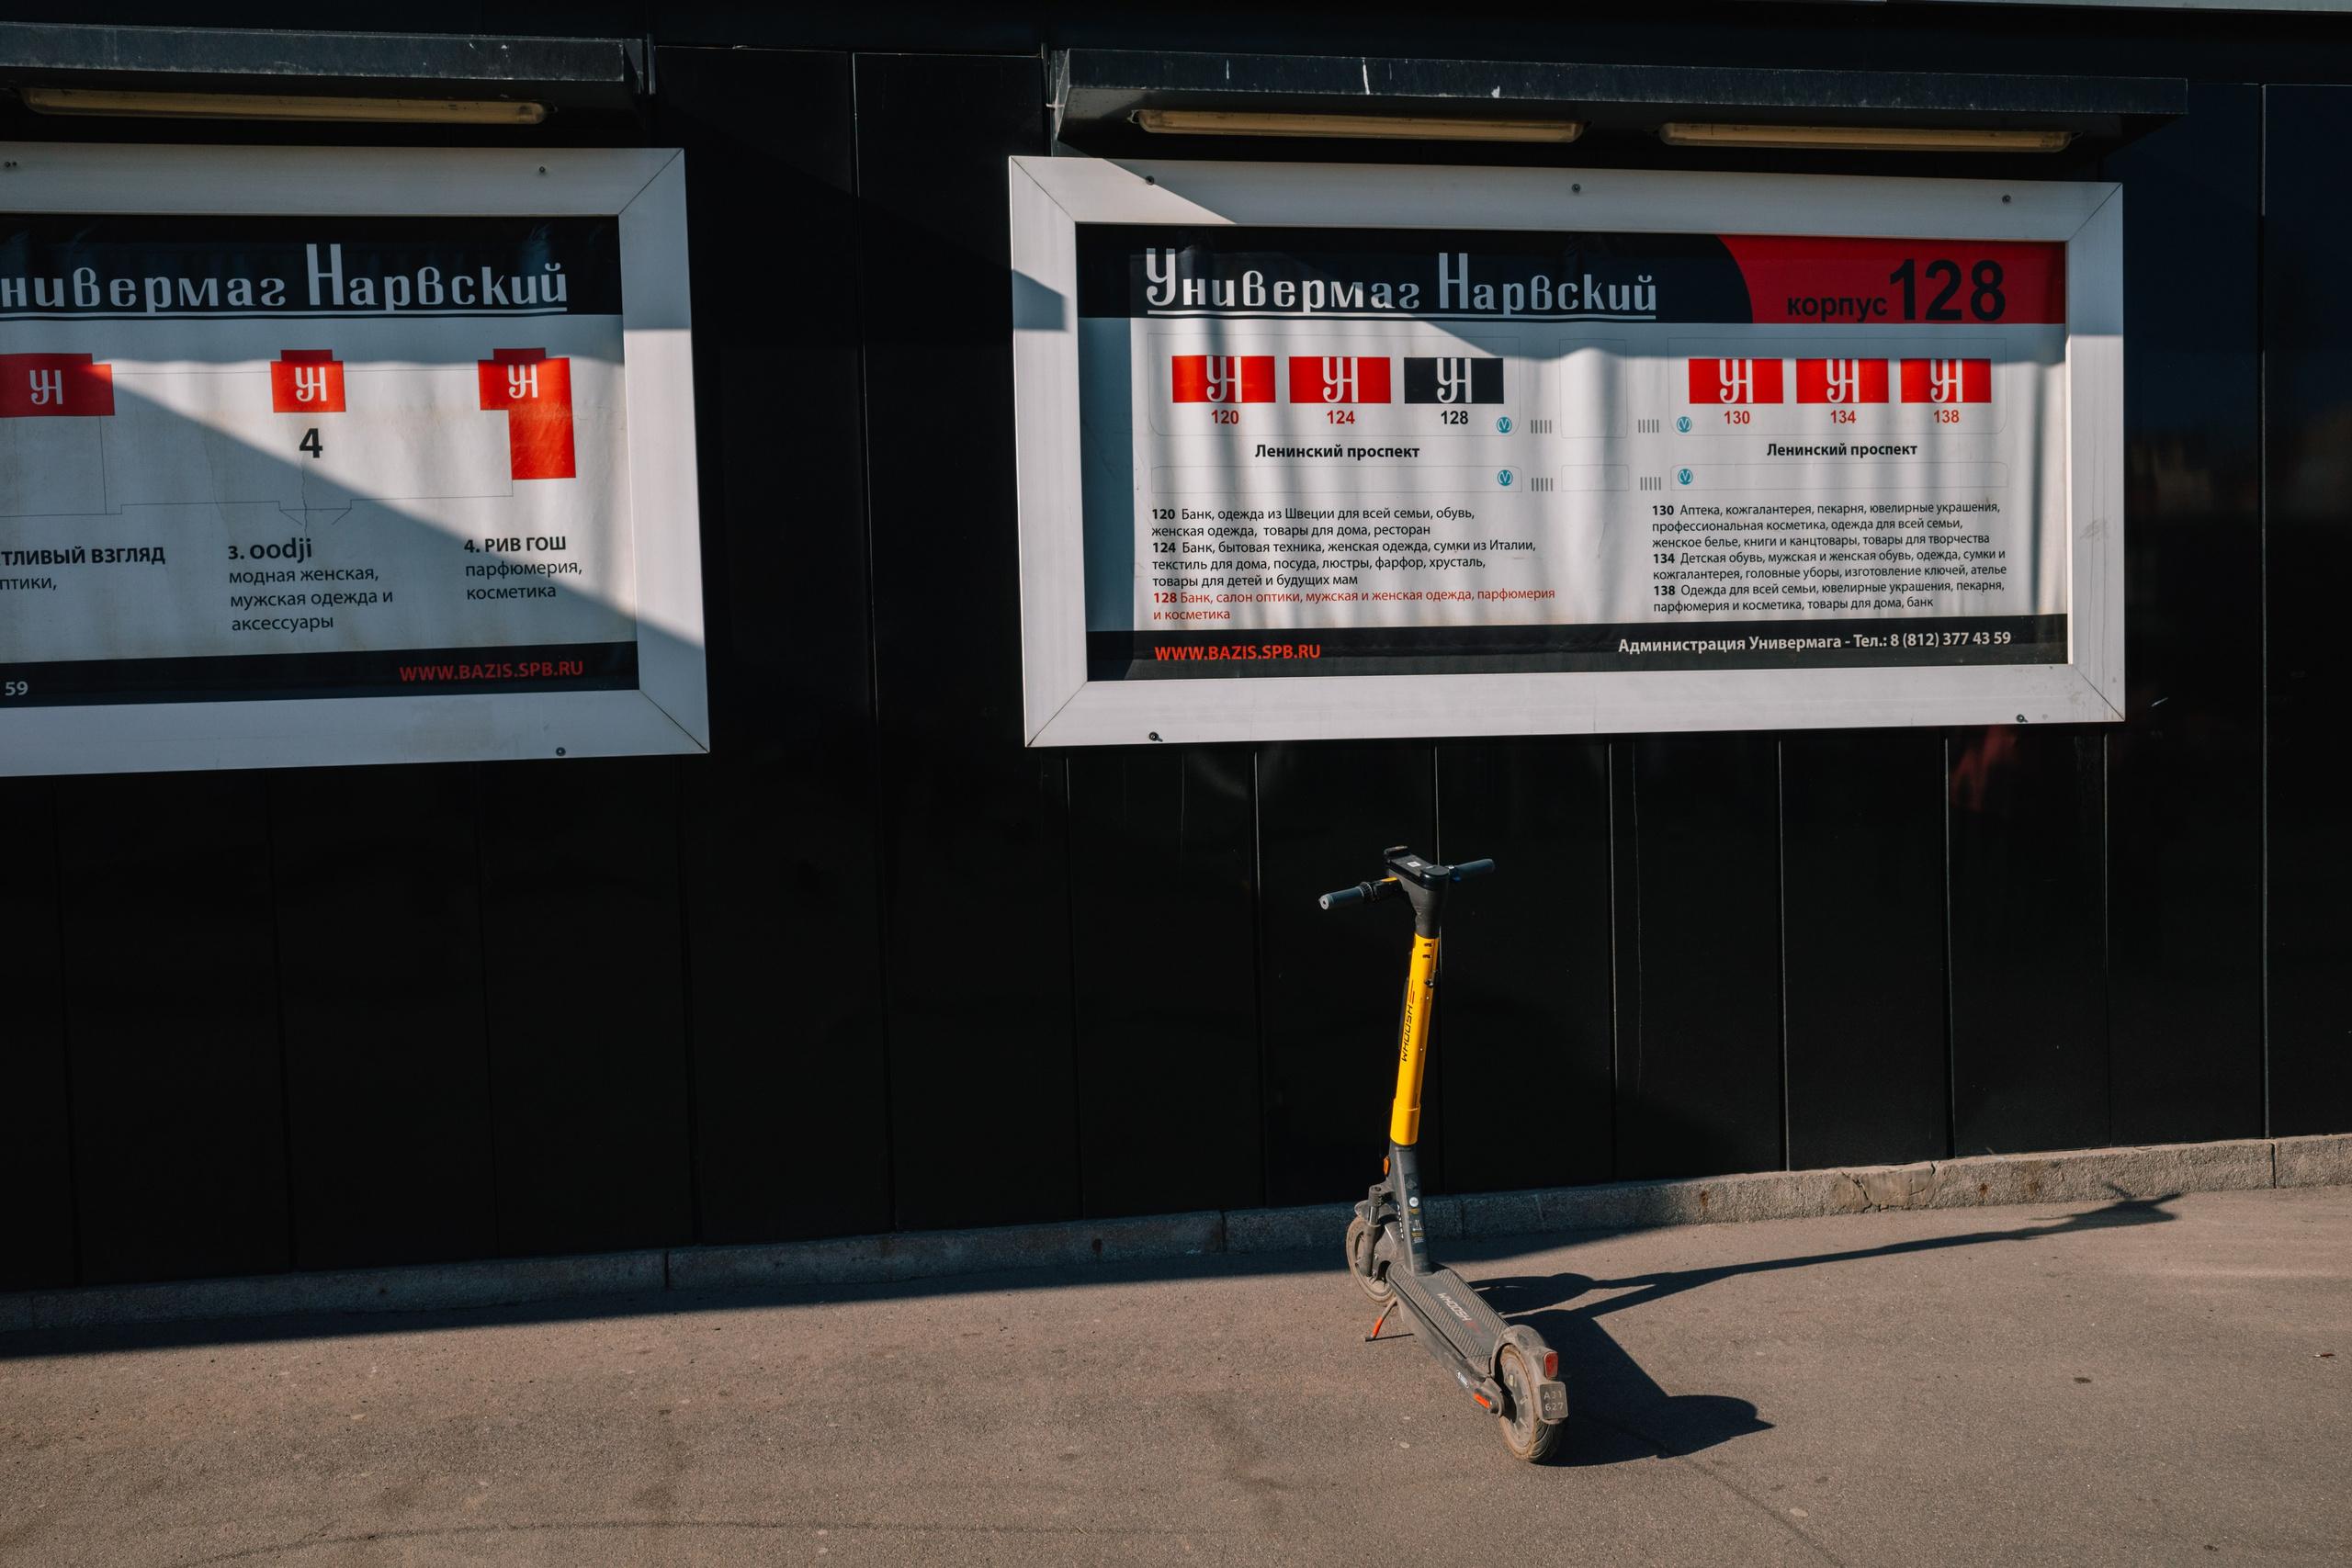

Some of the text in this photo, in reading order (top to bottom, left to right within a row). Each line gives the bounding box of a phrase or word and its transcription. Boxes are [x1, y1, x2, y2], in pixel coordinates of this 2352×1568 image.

[306, 243, 568, 311] Нарвский
[1146, 247, 1657, 315] Универмаг Нарвский
[1787, 258, 2007, 322] корпус 128
[1212, 410, 1239, 424] 120
[1327, 410, 1354, 424] 124
[1441, 410, 1468, 424] 128
[1724, 410, 1750, 424] 130
[1831, 410, 1856, 423] 134
[1935, 409, 1960, 423] 138
[298, 427, 324, 459] 4
[1766, 442, 1917, 458] Ленинский проспект
[1254, 444, 1419, 461] Ленинский проспект
[1152, 506, 1475, 521] 120 Банк, одежда из Швеции для всей семьи, обувь,
[1652, 503, 2000, 516] 130 Аптека, кожгалантерея, пекарня, ювелирные украшения,
[1151, 525, 1430, 538] женская одежда, товары для дома, ресторан
[1652, 517, 1962, 534] профессиональная косметика, одежда для всей семьи,
[228, 536, 311, 563] 3. oodji
[463, 536, 566, 553] 4. РИВ ГОШ
[1152, 539, 1535, 554] 124 Банк, бытовая техника, женская одежда, сумки из Италии,
[1652, 535, 1989, 547] женское белье, книги и канцтовары, товары для творчества
[0, 546, 165, 566] ТЛИВЫЙ ВЗГЛЯД
[1151, 556, 1486, 571] текстиль для дома, посуда, люстры, фарфор, хрусталь,
[1653, 548, 2005, 565] 134 Детская обувь, мужская и женская обувь, одежда, сумки и
[229, 568, 379, 586] модная женская,
[465, 559, 582, 580] парфюмерия,
[1653, 566, 2007, 581] кожгалантерея, головные уборы, изготовление ключей, ателье
[1152, 573, 1358, 590] товары для детей и будущих мам
[1654, 581, 2004, 597] 138 Одежда для всей семьи, ювелирные украшения, пекарня,
[231, 592, 392, 611] мужская одежда и
[467, 586, 556, 600] косметика
[1154, 592, 1177, 604] 128
[1181, 592, 1213, 604] Банк,
[1216, 594, 1252, 603] салон
[1255, 592, 1303, 603] оптики,
[1306, 592, 1358, 604] мужская
[1372, 592, 1422, 600] женская
[1425, 591, 1476, 601] одежда,
[1477, 587, 1555, 602] парфюмерия
[1653, 596, 1933, 615] парфюмерия и косметика, товары для дома, банк
[1153, 610, 1230, 620] и косметика
[232, 616, 334, 633] аксессуары
[1618, 638, 1745, 655] Администрация
[1748, 636, 1841, 651] Универмага
[1852, 634, 1887, 647] Тел.:
[1890, 633, 1899, 647] 8
[1903, 632, 1939, 649] (812)
[1942, 632, 1969, 645] 377
[1973, 631, 1990, 645] 43
[1994, 631, 2011, 644] 59
[1154, 644, 1320, 660] WWW.BAZIS.SPB.RU
[399, 660, 582, 681] WWW.BAZIS.SPB.RU
[5, 681, 28, 695] 59
[1401, 1003, 1413, 1062] WHOOSH
[1437, 1292, 1473, 1322] WHOOSH
[1544, 1402, 1564, 1412] 627
